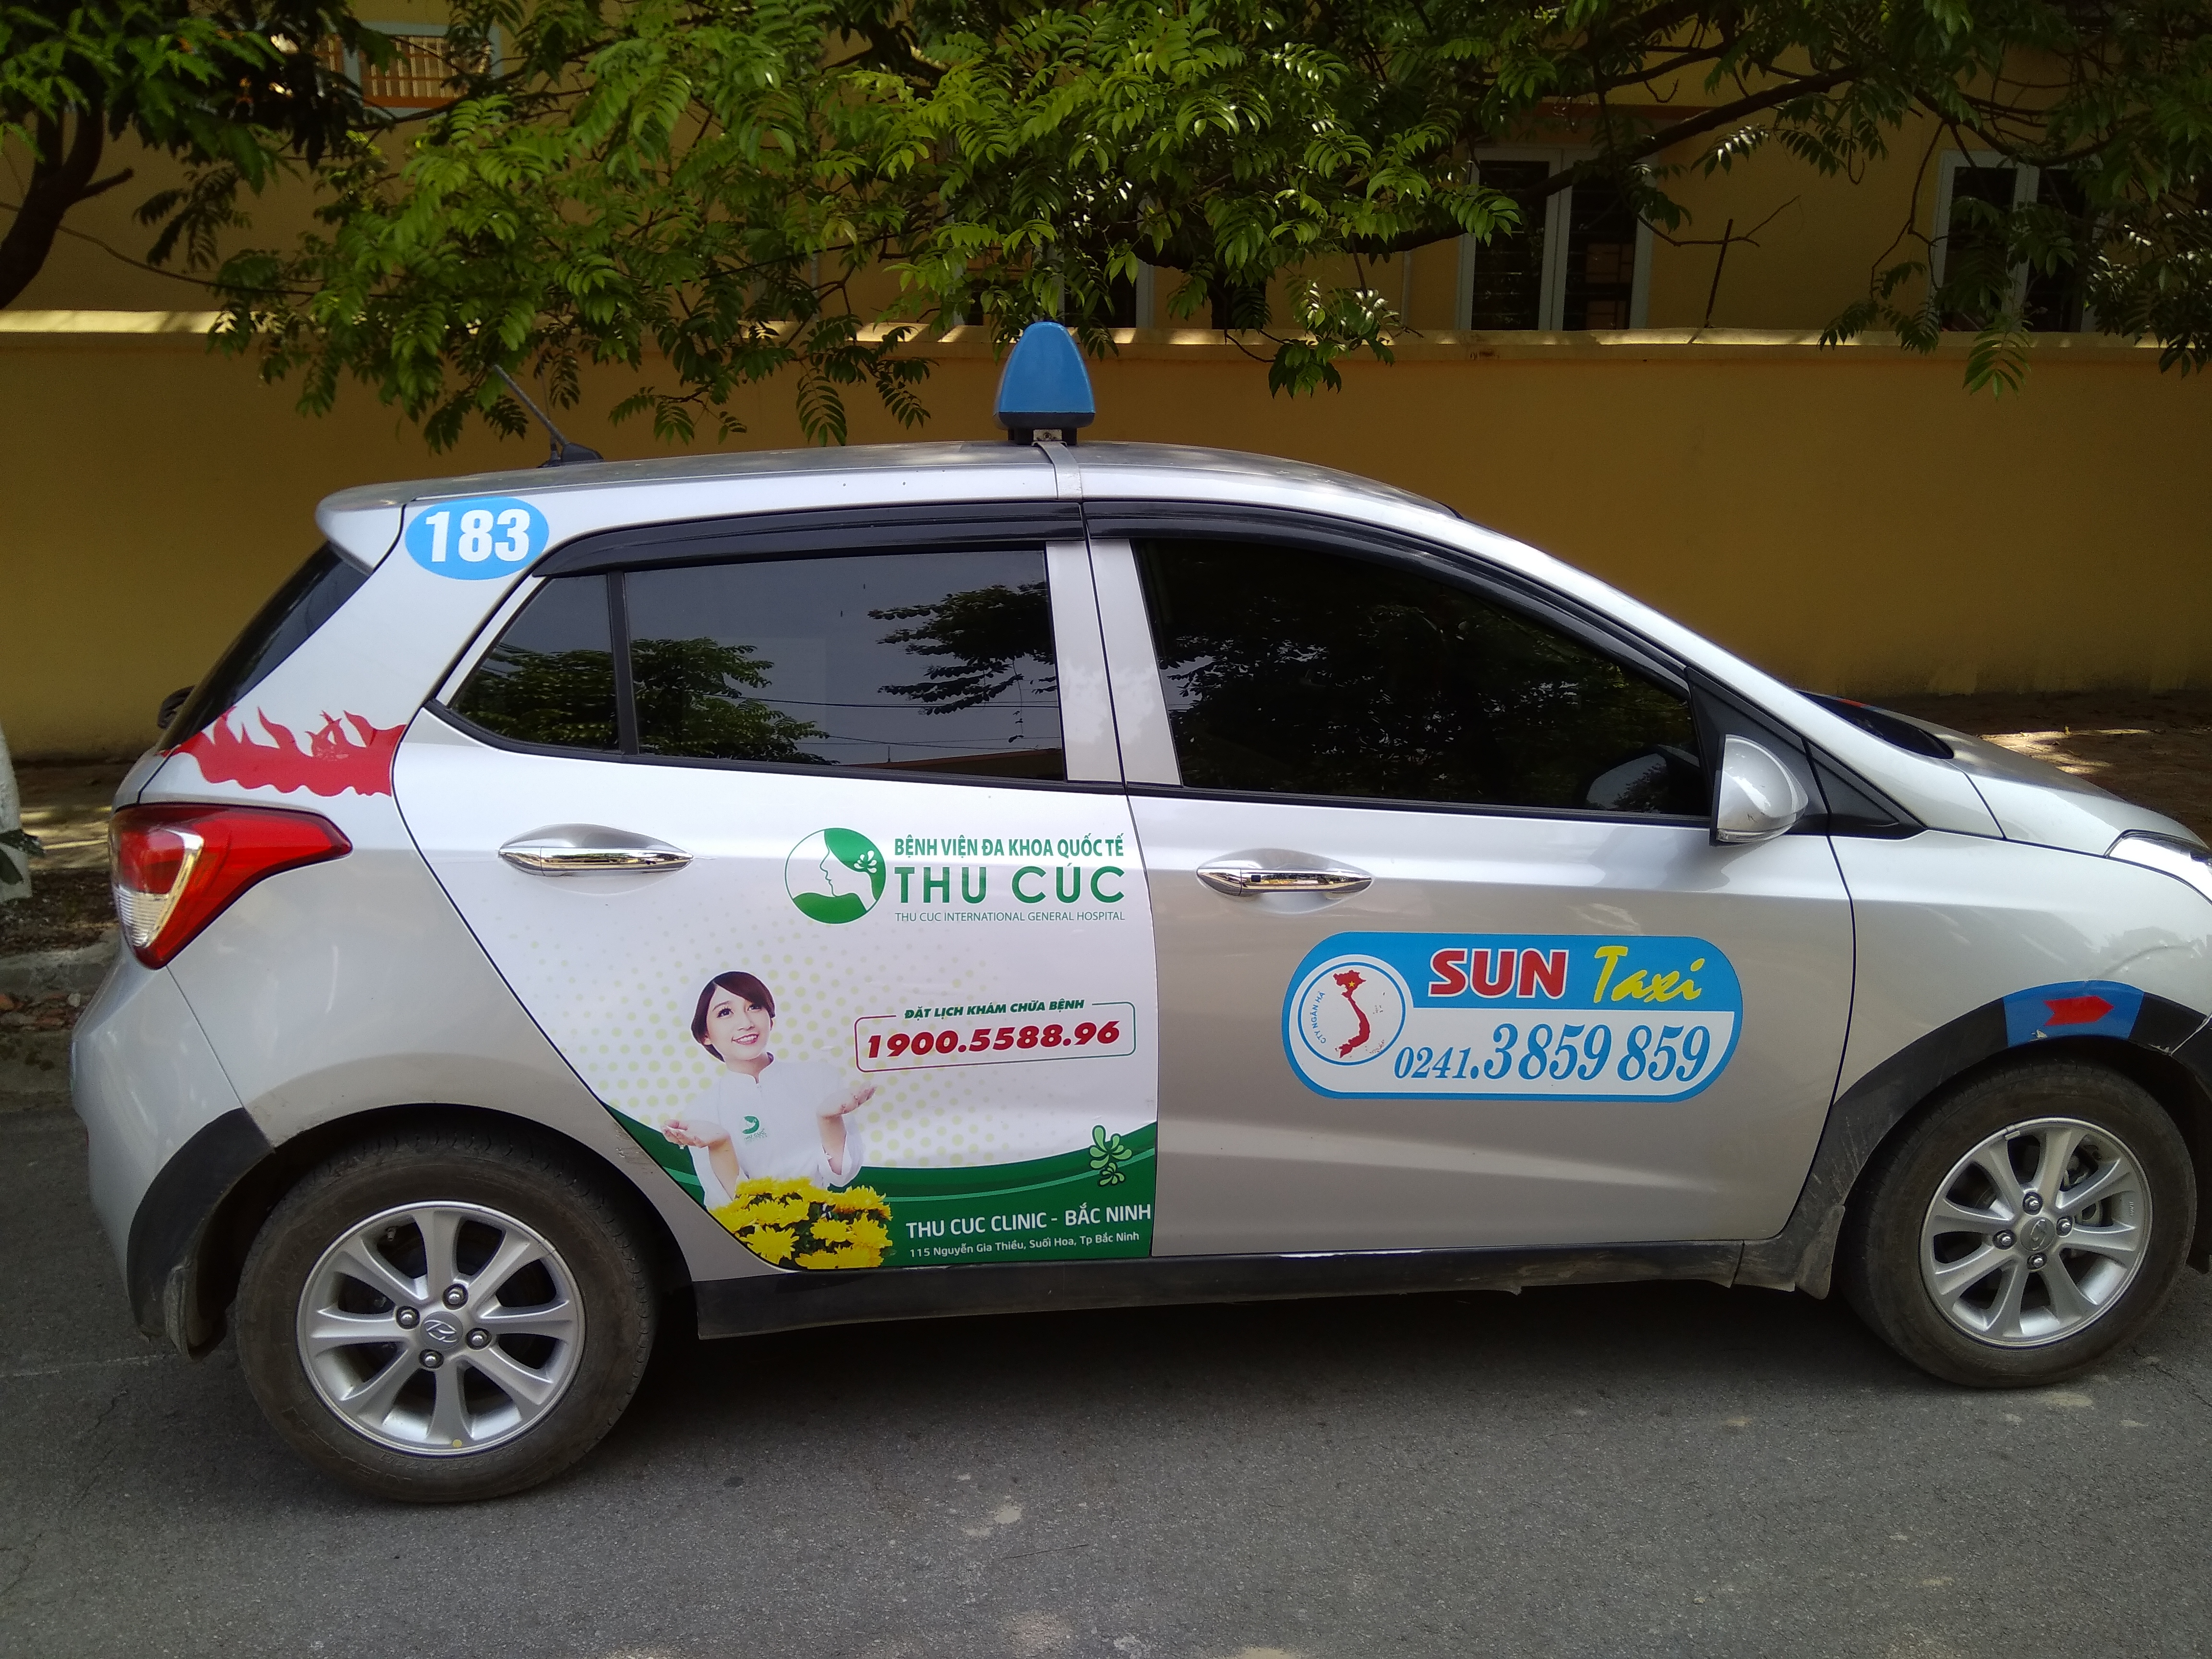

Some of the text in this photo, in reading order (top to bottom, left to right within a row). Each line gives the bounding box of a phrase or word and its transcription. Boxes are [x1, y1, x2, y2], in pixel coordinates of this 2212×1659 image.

[426, 509, 530, 562] 183
[895, 832, 1124, 859] BỆNH VIỆN ĐA KHOA QUỐC TẾ
[895, 863, 1125, 904] THU CÚC
[895, 911, 1125, 922] THU CUC INTERNATIONAL GENERAL HOSPITAL
[1429, 946, 1704, 1003] SUN Taxi
[904, 998, 1085, 1022] ĐẶT LỊCH KHÁM CHỮA BỆNH
[1310, 1004, 1319, 1029] NGÂN
[868, 1020, 1120, 1059] 1900.5588.96
[1313, 1030, 1327, 1044] CTY
[1617, 1024, 1711, 1082] 859
[905, 1220, 945, 1239] THU
[950, 1216, 986, 1235] CUC
[991, 1212, 1047, 1232] CLINIC
[1065, 1202, 1101, 1226] BẮC
[1106, 1203, 1151, 1223] NINH
[909, 1231, 1140, 1258] 115 Nguyễn Gia Thiều, Suối Hoa, Tp Bắc Ninh
